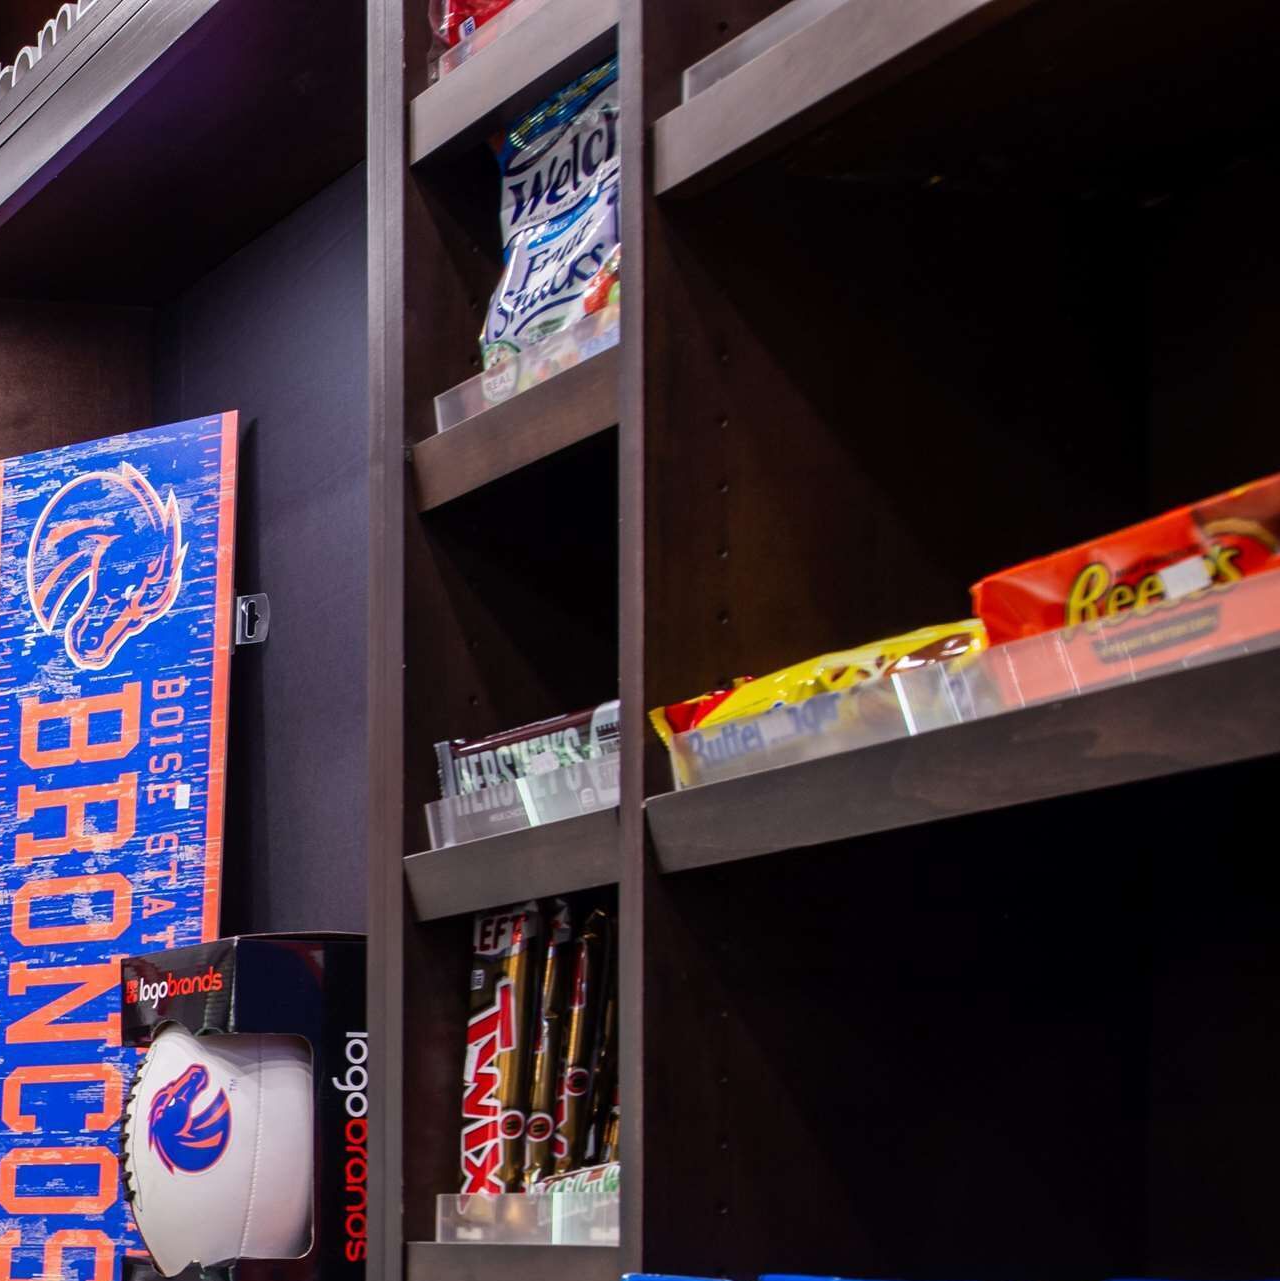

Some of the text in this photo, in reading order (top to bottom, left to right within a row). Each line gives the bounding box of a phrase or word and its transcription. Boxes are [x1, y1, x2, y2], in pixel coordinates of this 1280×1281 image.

[140, 674, 188, 948] BOISE STAT
[139, 965, 224, 1009] logobrands
[473, 913, 528, 952] EFT
[457, 976, 516, 1214] TWIX
